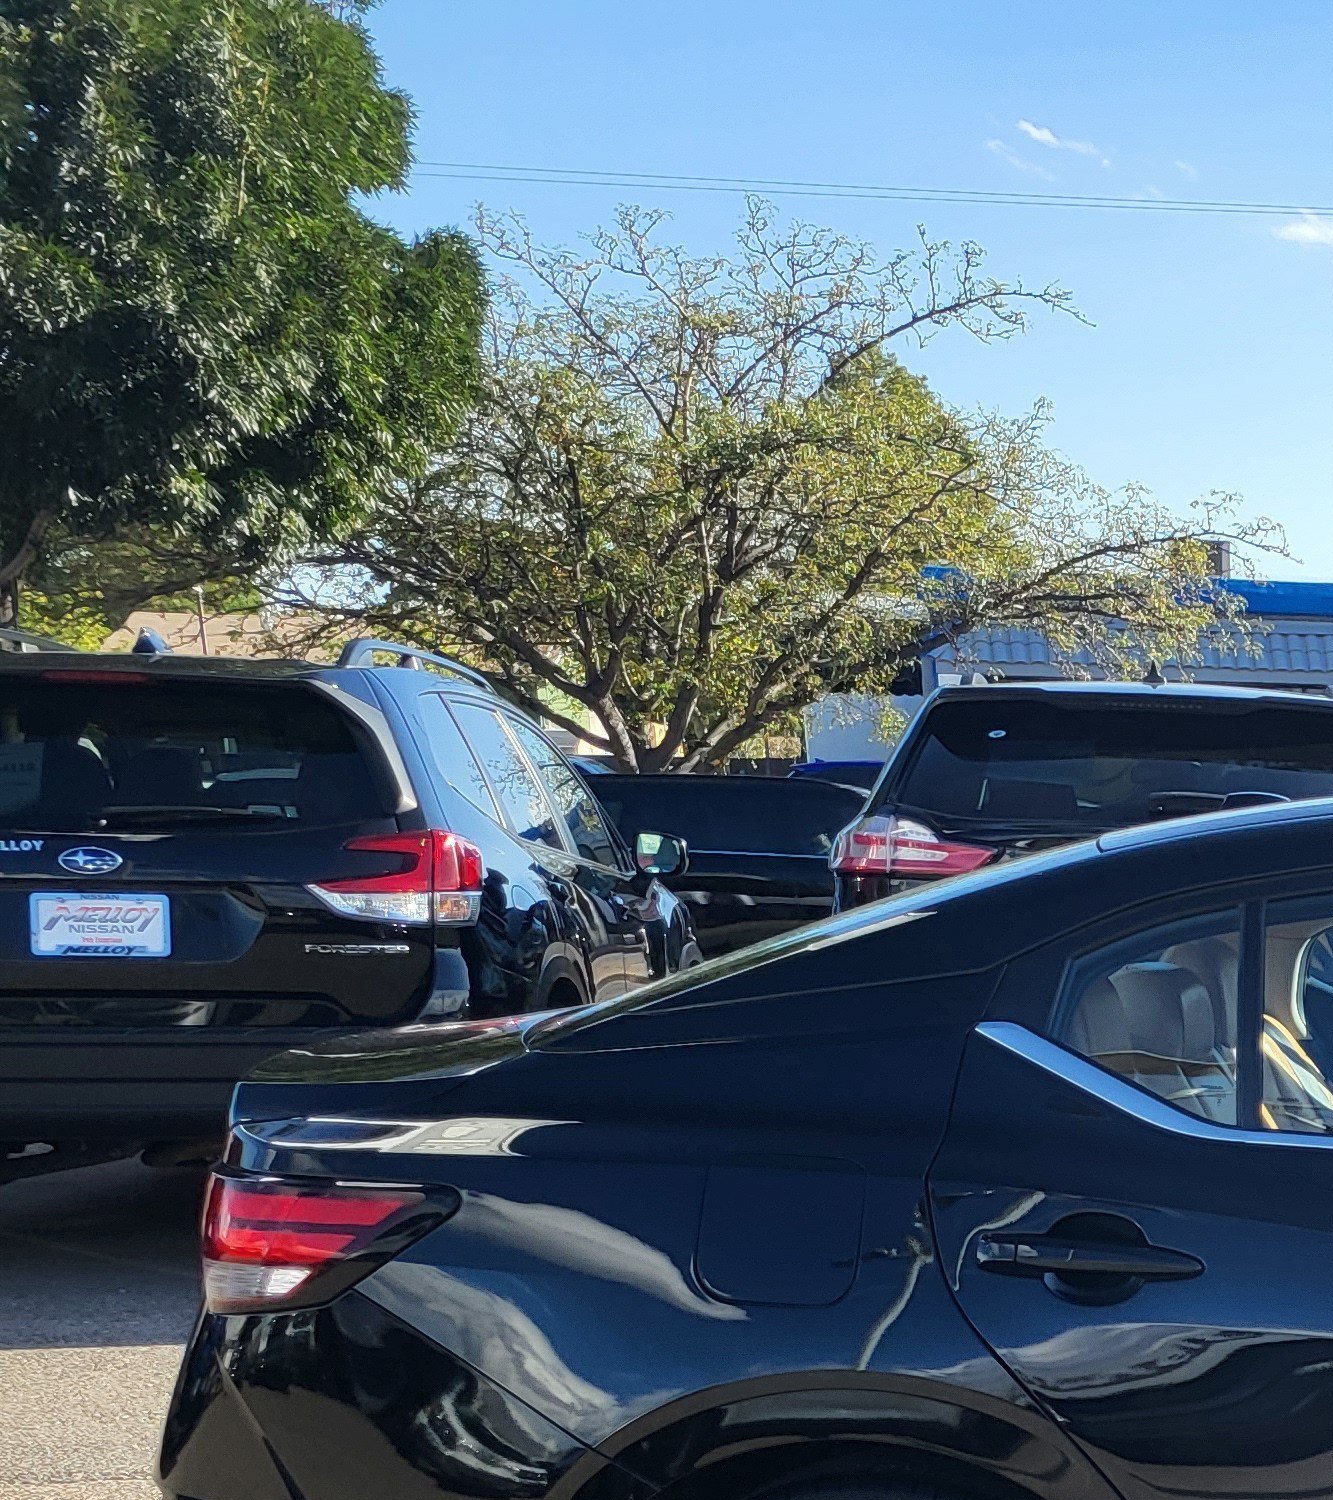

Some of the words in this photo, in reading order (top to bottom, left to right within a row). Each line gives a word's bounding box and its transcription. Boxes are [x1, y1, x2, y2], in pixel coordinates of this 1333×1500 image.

[43, 906, 159, 932] MELLOY
[69, 925, 134, 934] NISSAN
[62, 945, 135, 954] MELLOY
